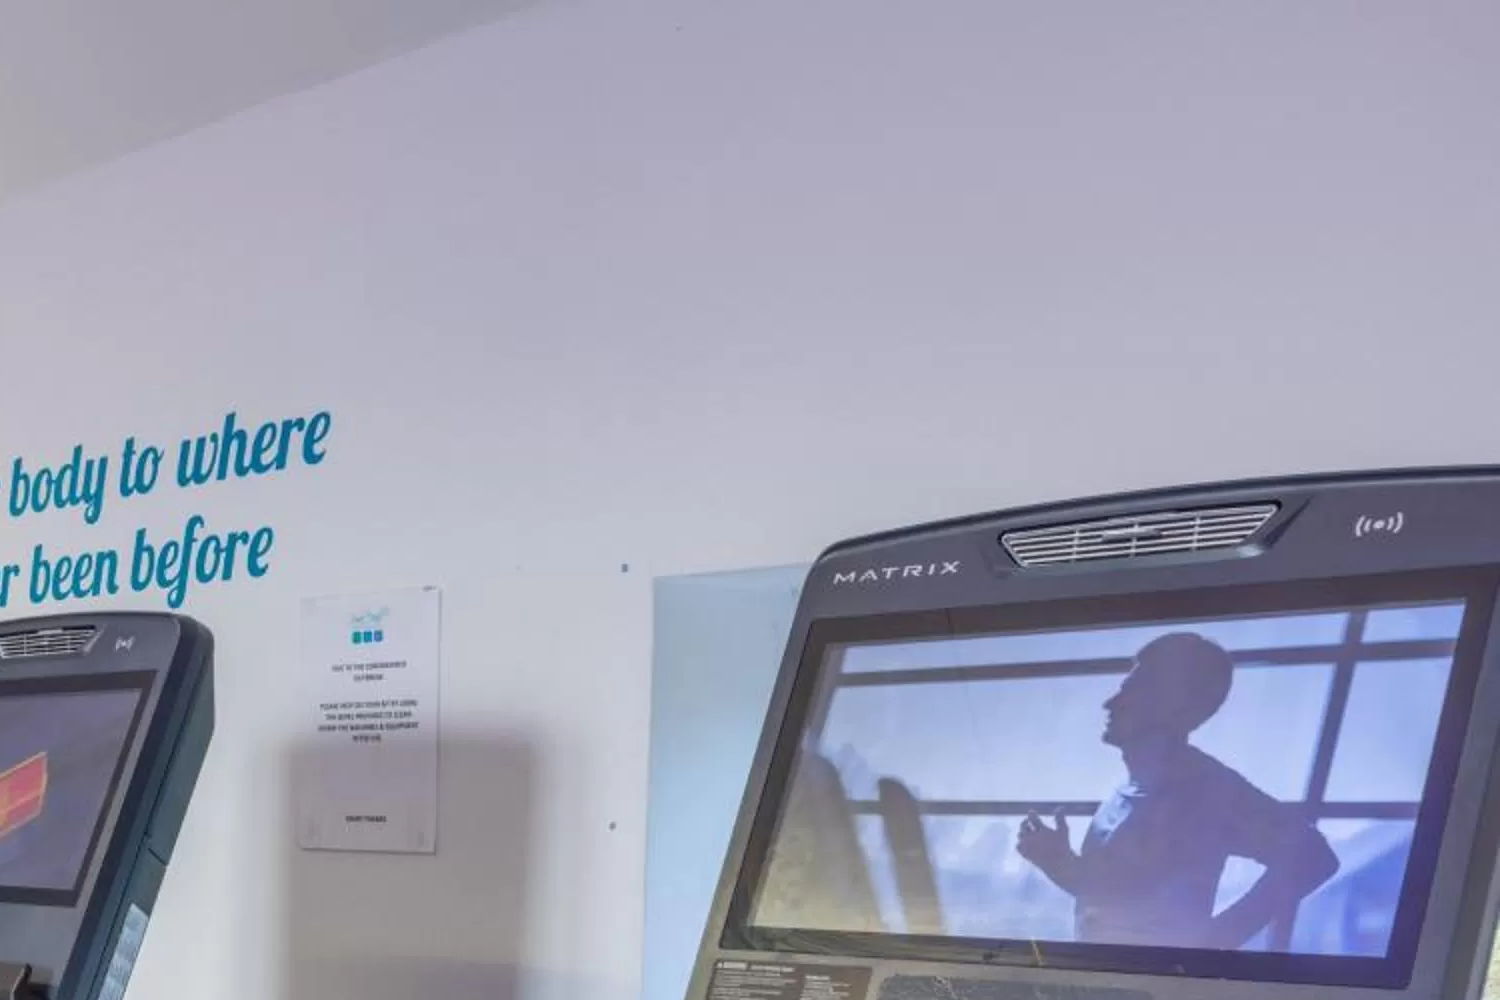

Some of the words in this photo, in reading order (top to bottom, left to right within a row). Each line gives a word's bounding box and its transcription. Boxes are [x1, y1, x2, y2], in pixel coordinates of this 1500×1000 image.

[8, 445, 108, 525] body
[119, 437, 164, 499] to
[175, 411, 332, 488] where
[29, 544, 119, 605] been
[130, 514, 275, 609] before
[832, 560, 961, 586] MATRIX
